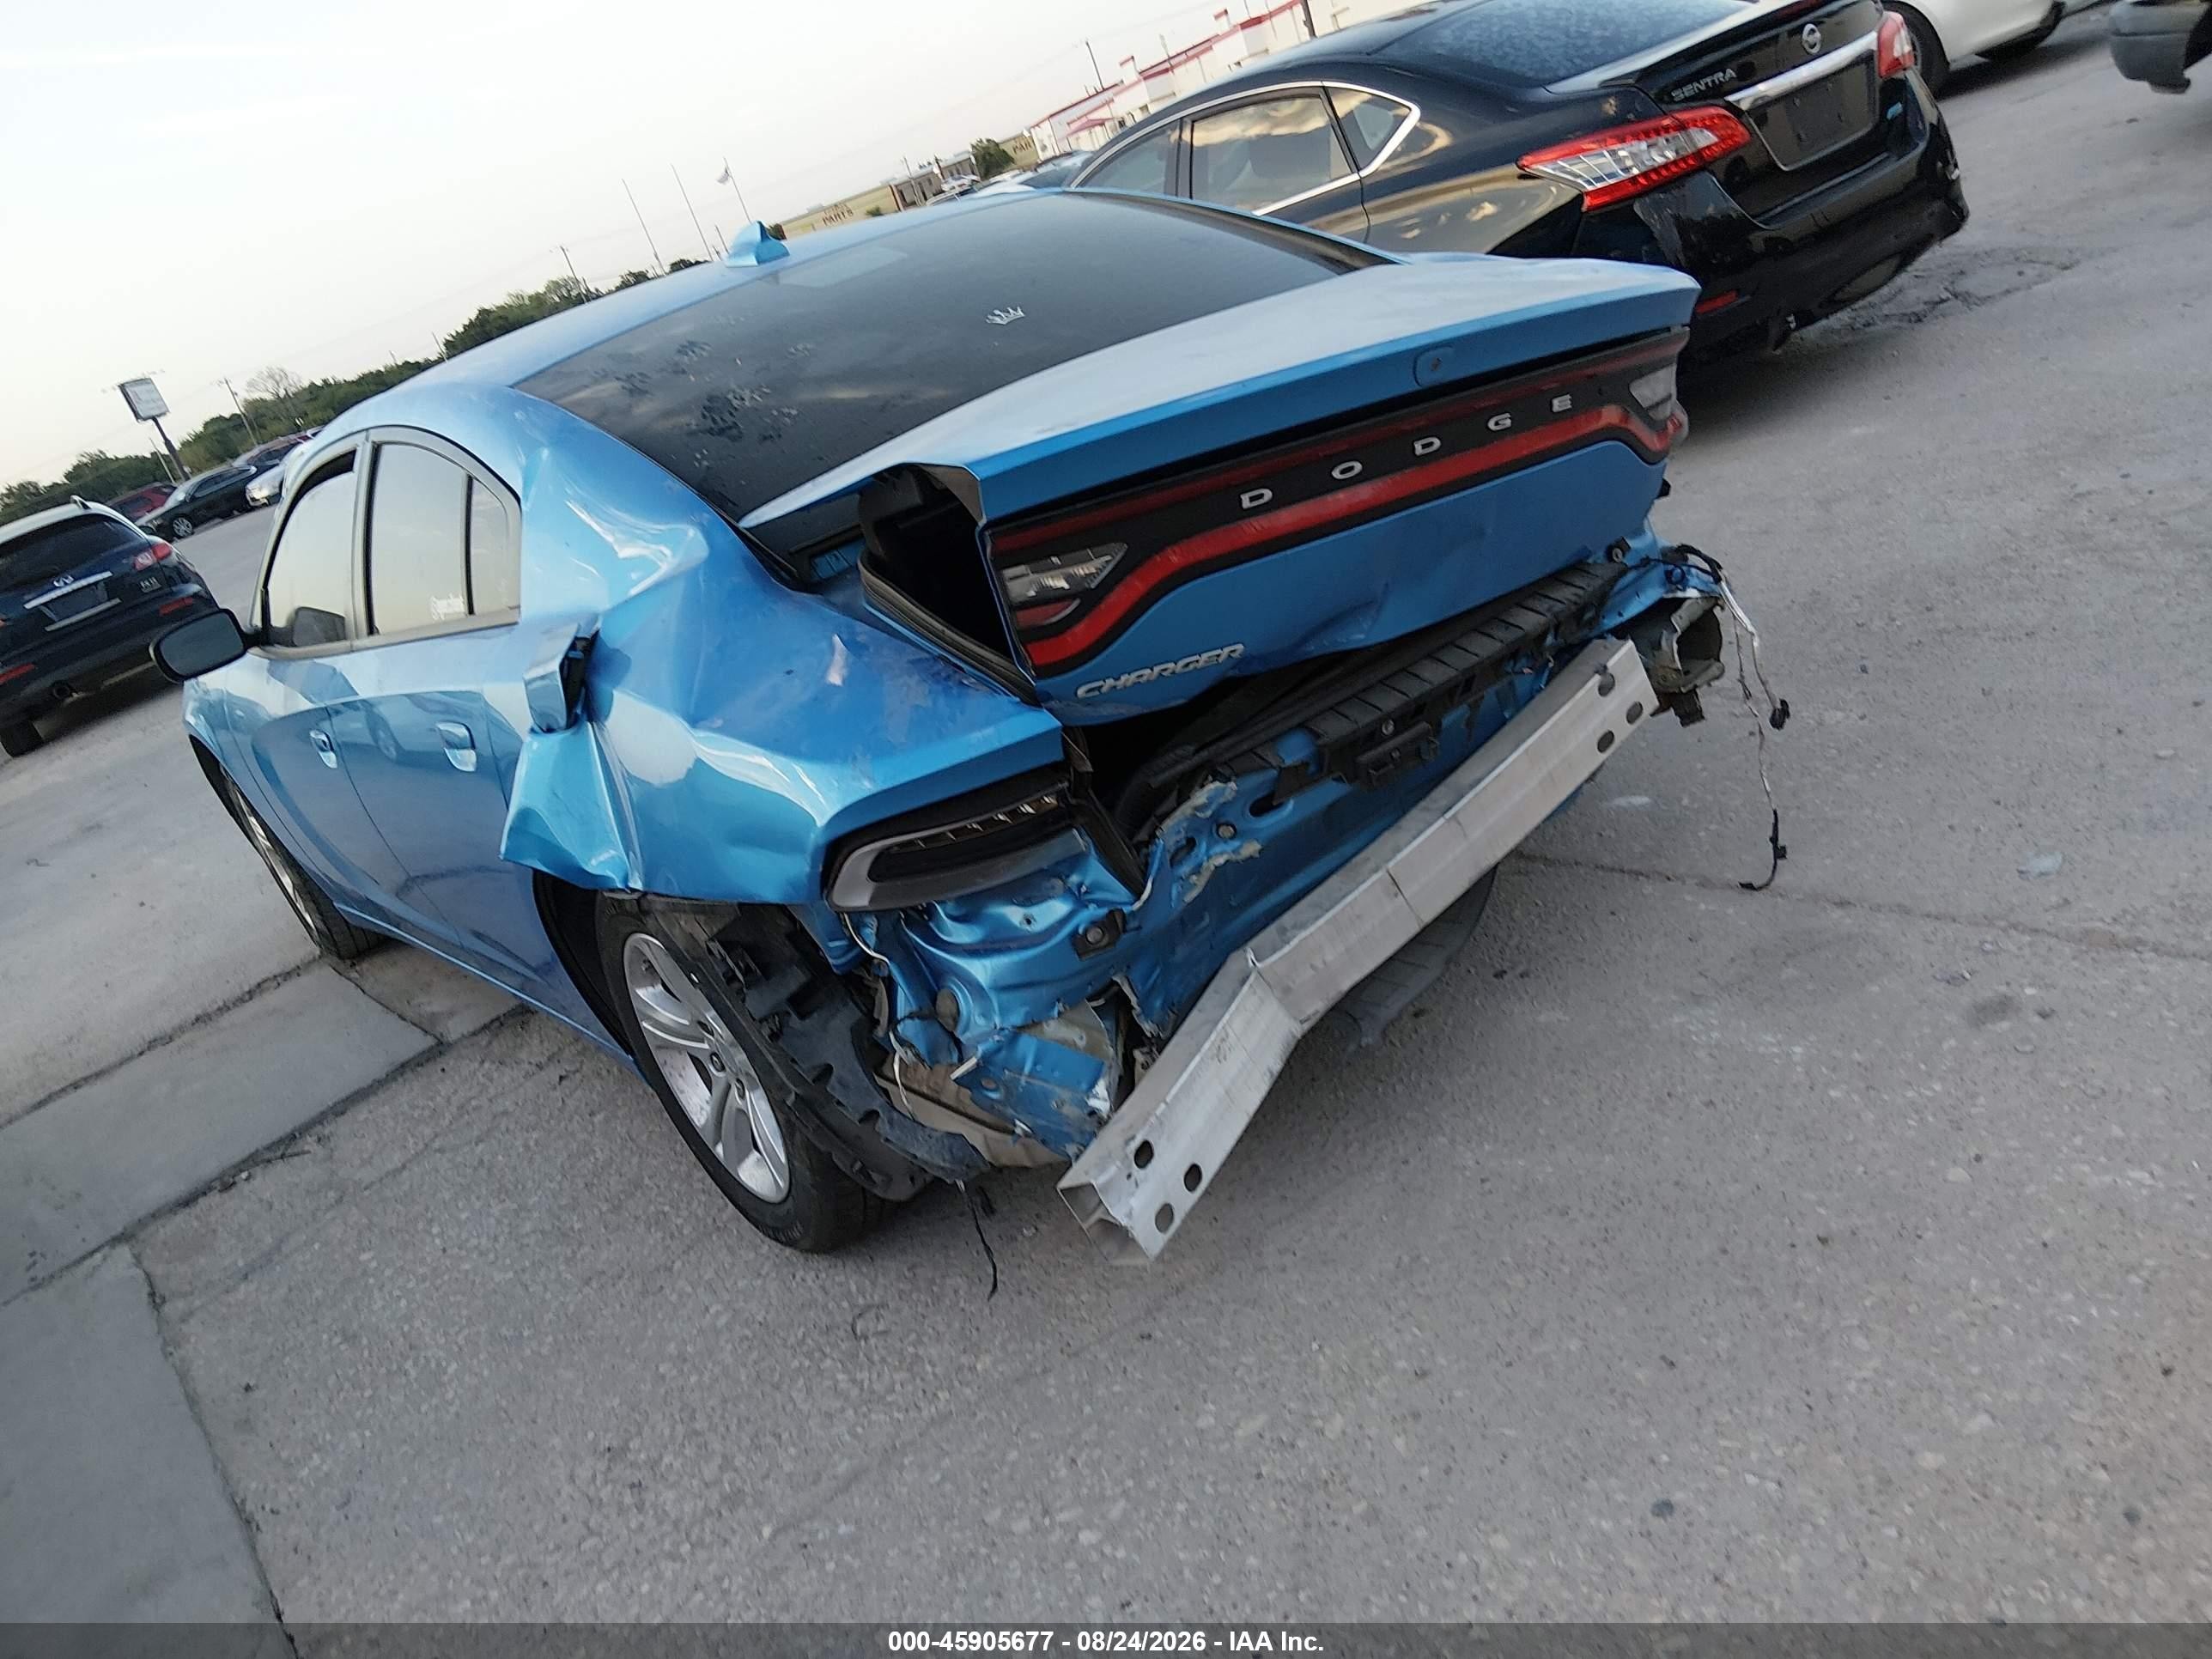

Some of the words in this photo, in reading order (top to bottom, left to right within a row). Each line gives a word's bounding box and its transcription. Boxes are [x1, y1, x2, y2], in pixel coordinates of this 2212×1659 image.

[1671, 69, 1737, 101] SENTRA
[1240, 394, 1573, 510] DODGE
[1077, 643, 1244, 699] CHARGER
